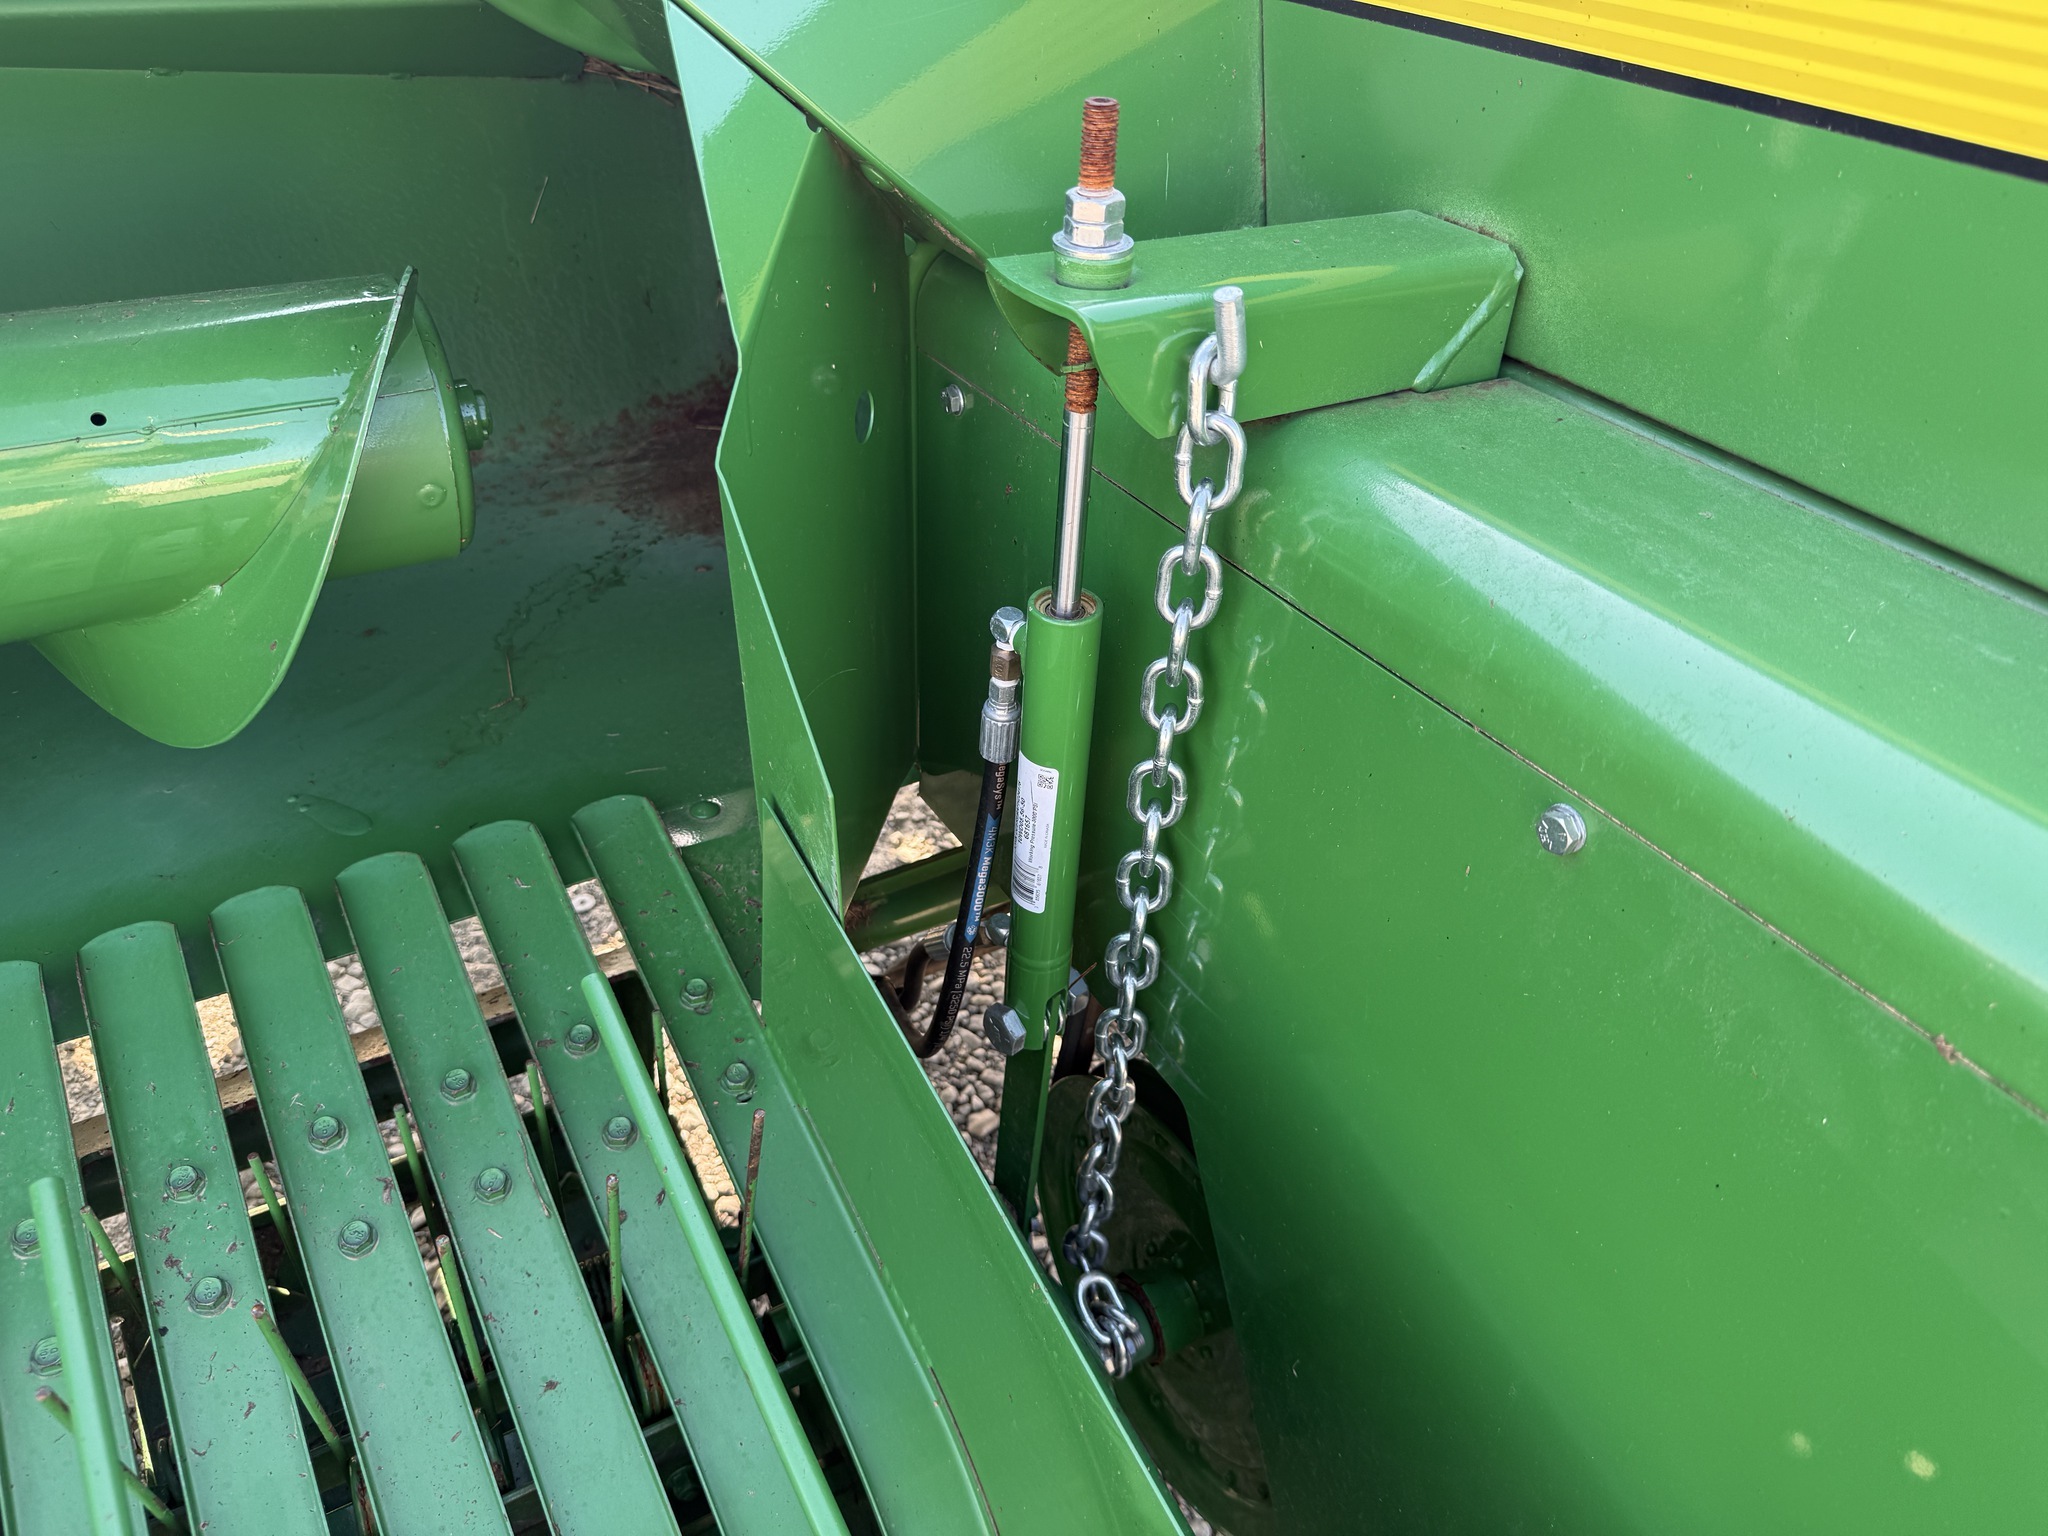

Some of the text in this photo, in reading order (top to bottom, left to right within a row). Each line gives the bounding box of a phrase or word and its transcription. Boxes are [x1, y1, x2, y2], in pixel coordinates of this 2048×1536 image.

[985, 826, 998, 855] 4M3K
[959, 946, 973, 968] 22.5
[954, 969, 967, 989] MPa
